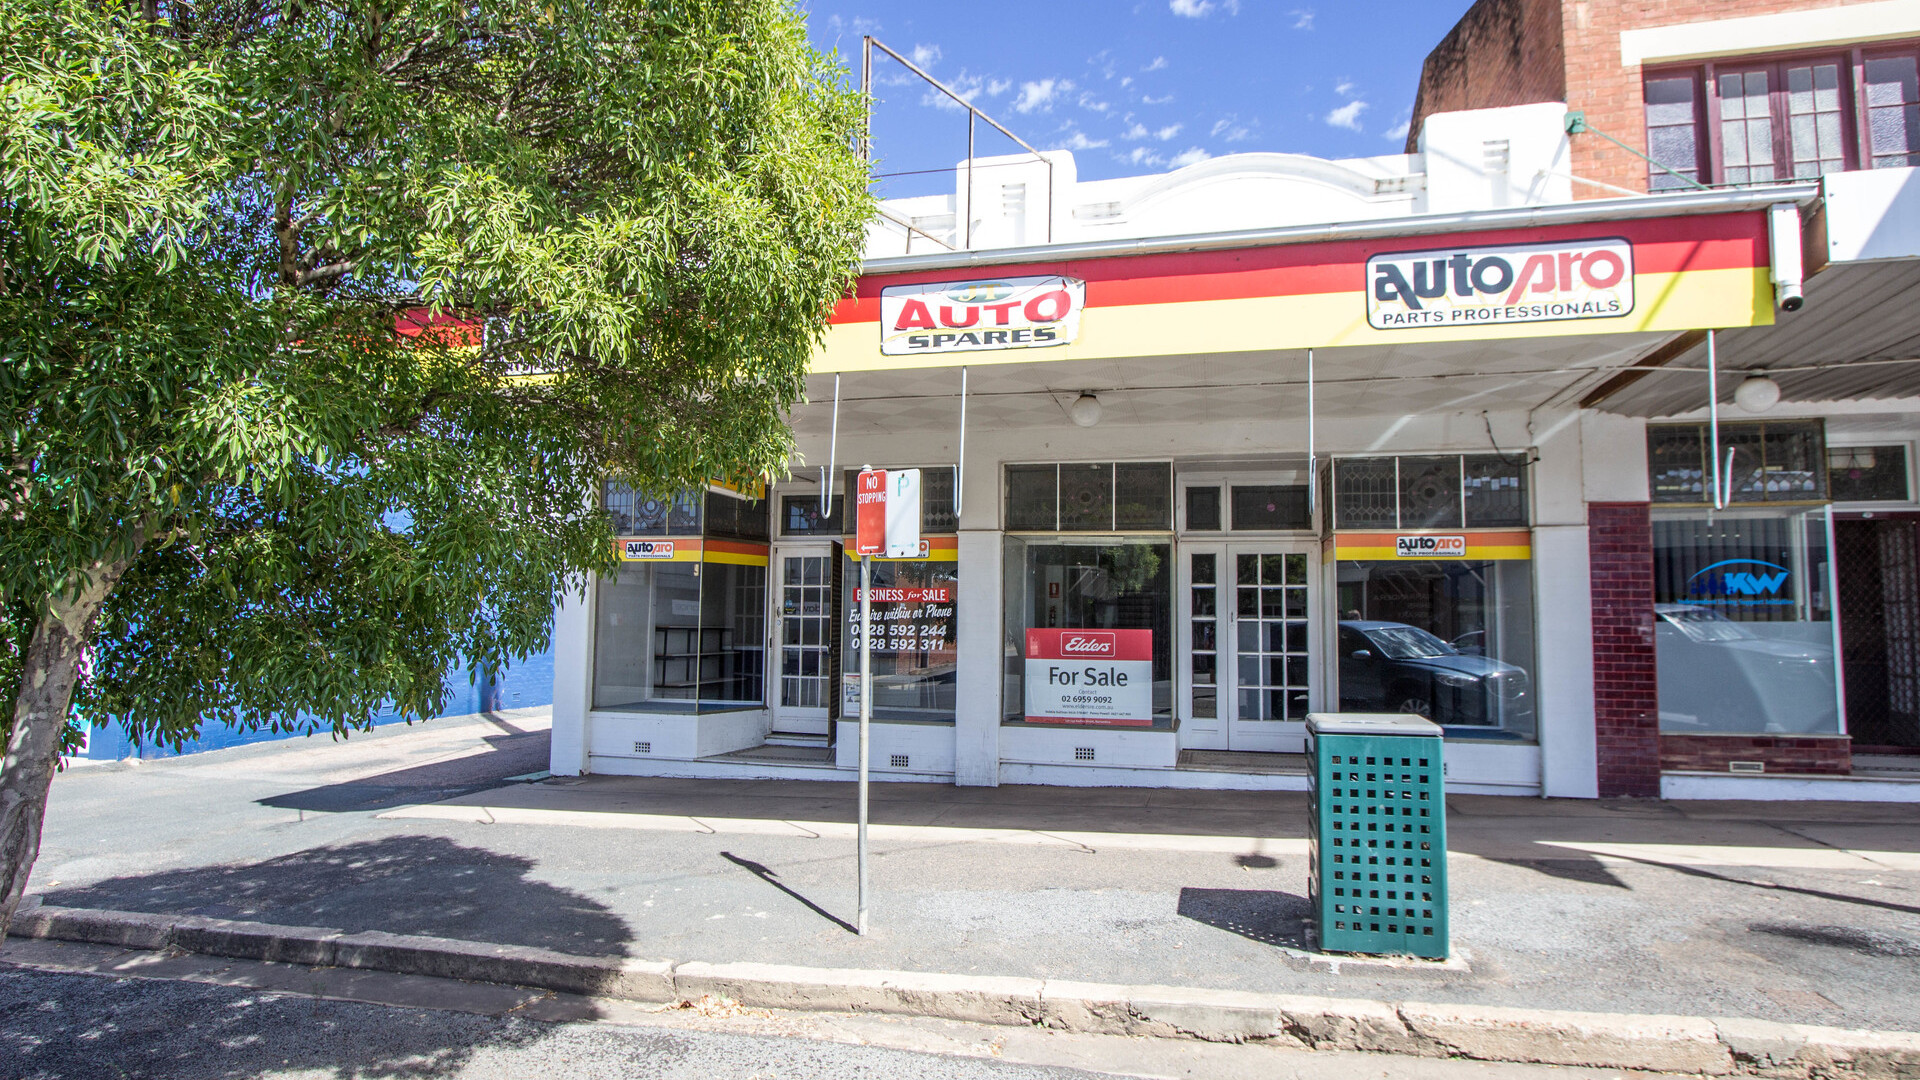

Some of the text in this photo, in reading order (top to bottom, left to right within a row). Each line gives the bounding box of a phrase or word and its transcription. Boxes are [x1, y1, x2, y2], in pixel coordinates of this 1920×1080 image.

[958, 283, 1001, 302] JT
[894, 290, 1071, 331] AUTO
[1383, 300, 1619, 325] PARTS PROFESSIONALS
[908, 327, 1056, 349] SPARES
[866, 476, 878, 490] NO
[858, 491, 886, 504] STOPPING
[857, 589, 946, 601] BSINESS for SALE
[849, 608, 883, 622] Enire
[883, 605, 911, 620] within
[912, 611, 923, 620] or
[925, 604, 953, 619] Phone
[850, 624, 947, 637] 028 592 244
[851, 638, 944, 650] 028 592 311
[1065, 637, 1111, 652] Elders
[1049, 667, 1128, 687] For Sale
[1061, 695, 1071, 703] 02
